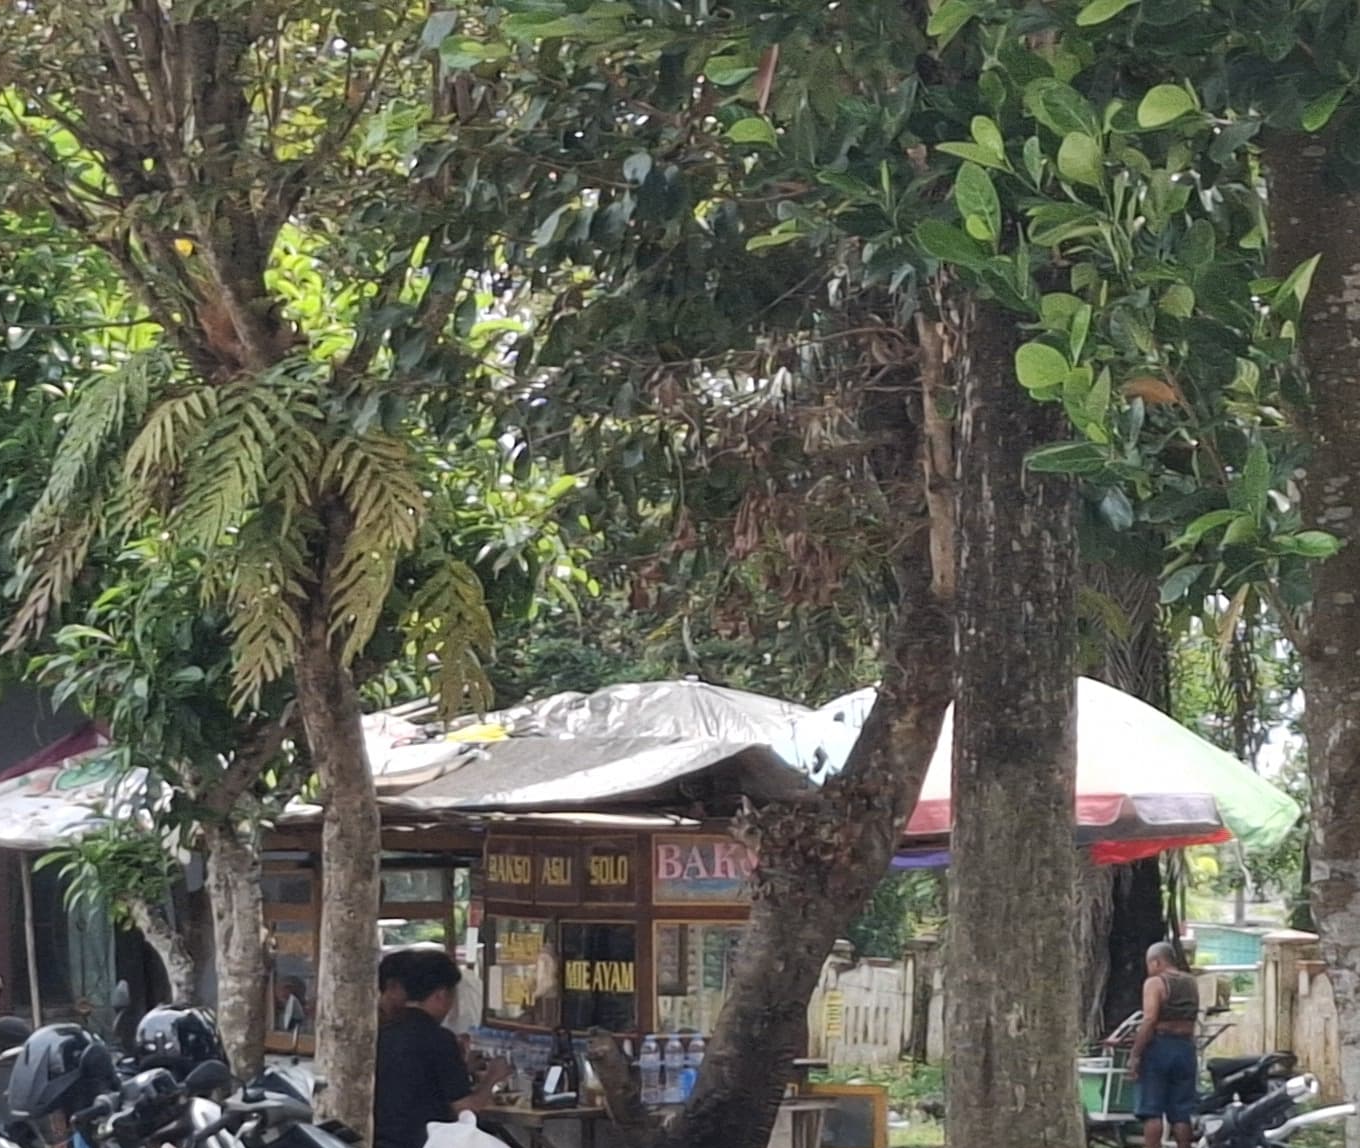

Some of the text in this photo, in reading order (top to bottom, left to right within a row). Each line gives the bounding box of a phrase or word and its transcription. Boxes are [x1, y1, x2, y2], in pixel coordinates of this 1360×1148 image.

[489, 853, 628, 886] BAKSO ASLI SOLO
[565, 960, 590, 990] MIE
[593, 961, 635, 993] AYAM
